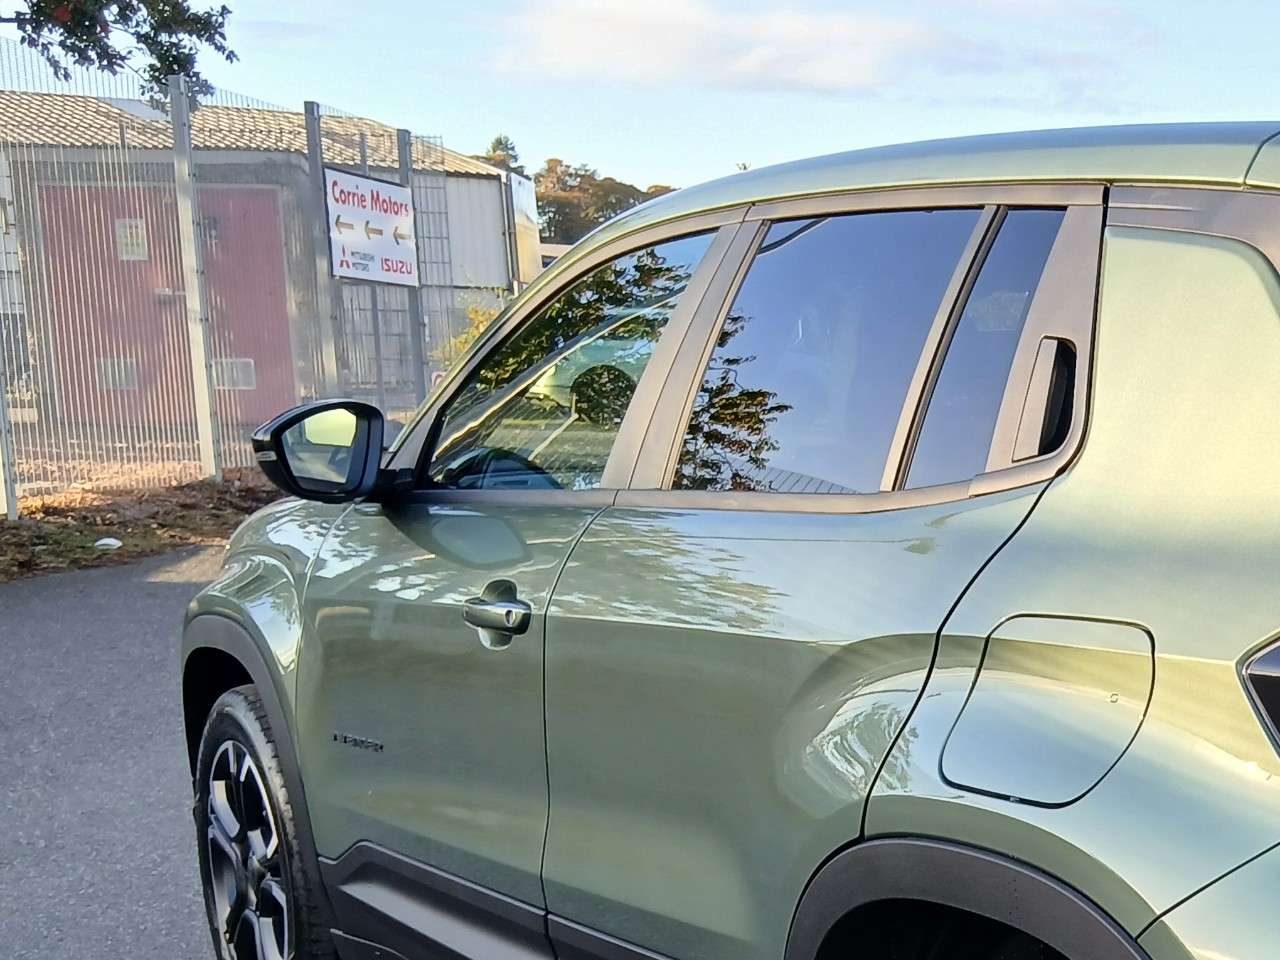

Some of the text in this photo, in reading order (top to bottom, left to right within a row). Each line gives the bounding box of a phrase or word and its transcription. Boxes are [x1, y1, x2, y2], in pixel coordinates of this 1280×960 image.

[332, 180, 409, 217] Corrie Motors
[381, 257, 412, 275] ISUZU
